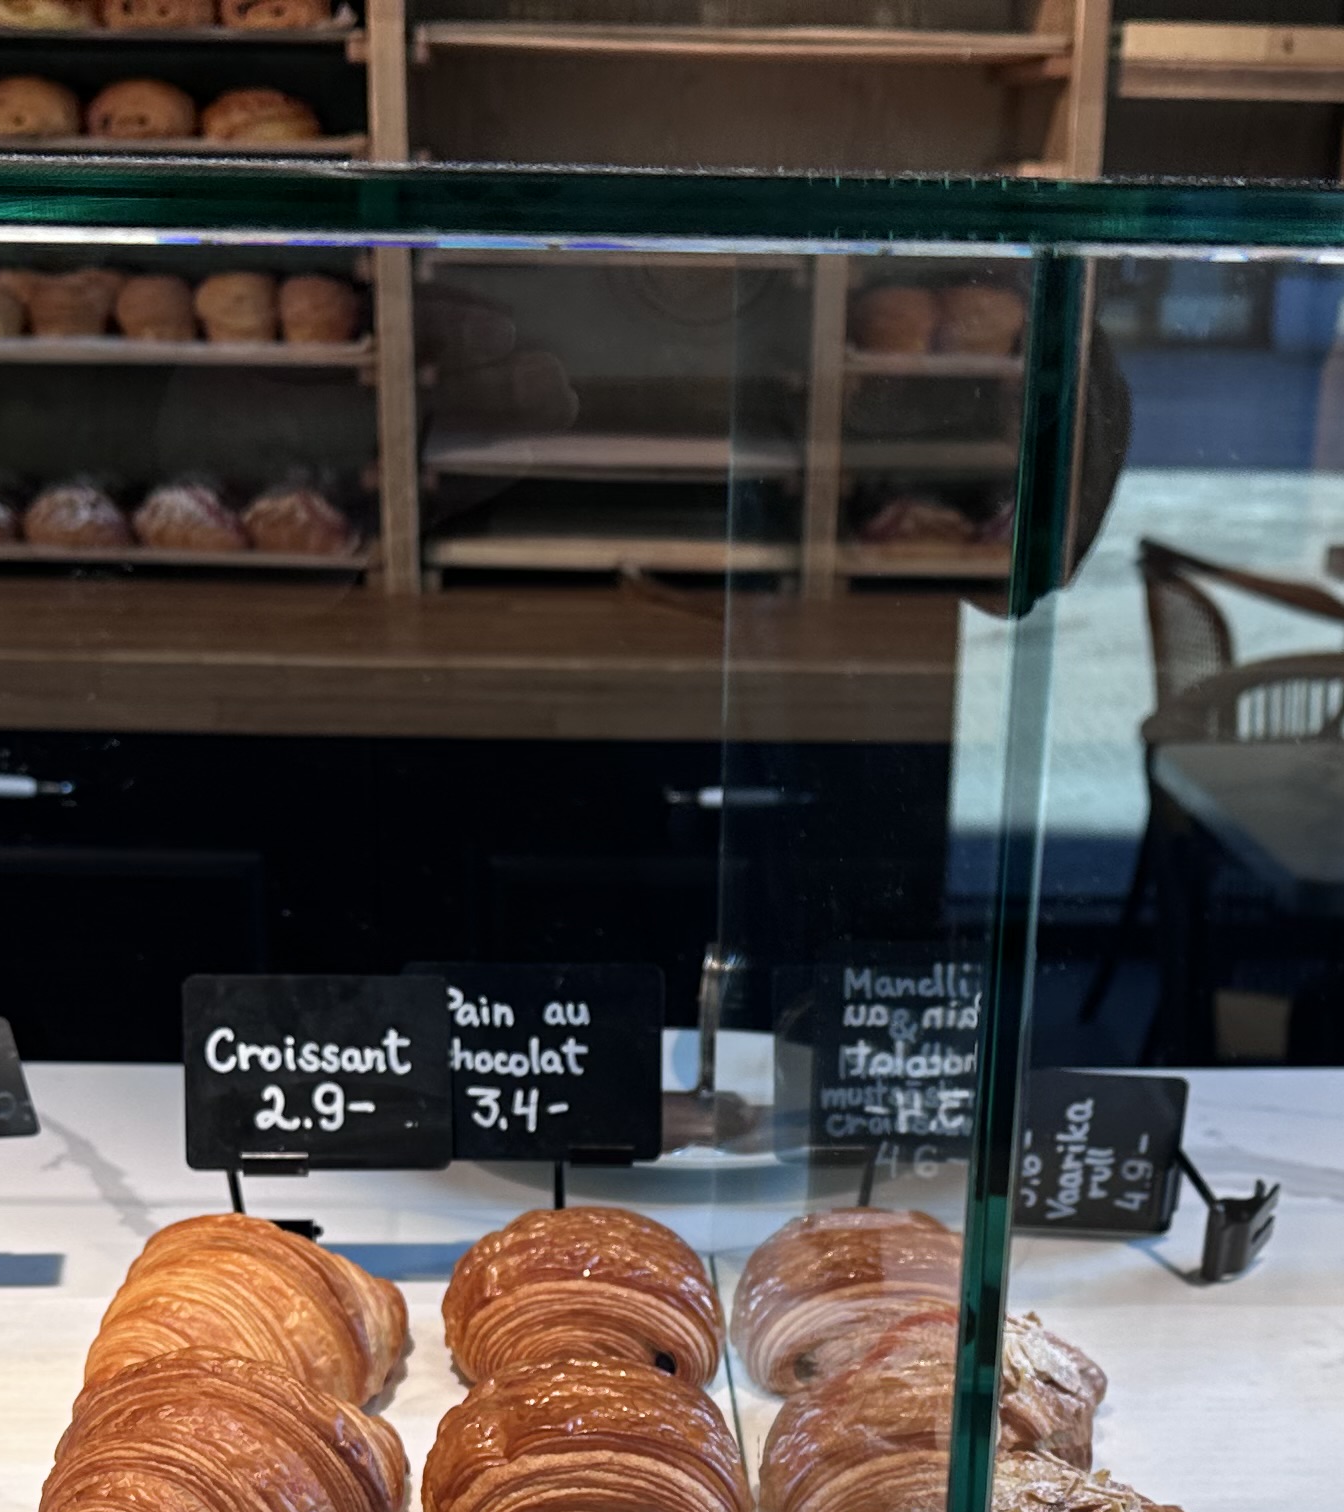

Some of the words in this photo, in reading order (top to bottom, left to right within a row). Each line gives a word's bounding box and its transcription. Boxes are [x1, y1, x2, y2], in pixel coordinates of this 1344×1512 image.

[543, 1001, 591, 1027] au
[205, 1027, 413, 1075] Croissant
[448, 1035, 590, 1077] hocolat
[254, 1081, 377, 1132] 2.9-
[466, 1087, 570, 1133] 3.4-
[1044, 1096, 1096, 1221] Vaarika
[1083, 1147, 1117, 1200] rull
